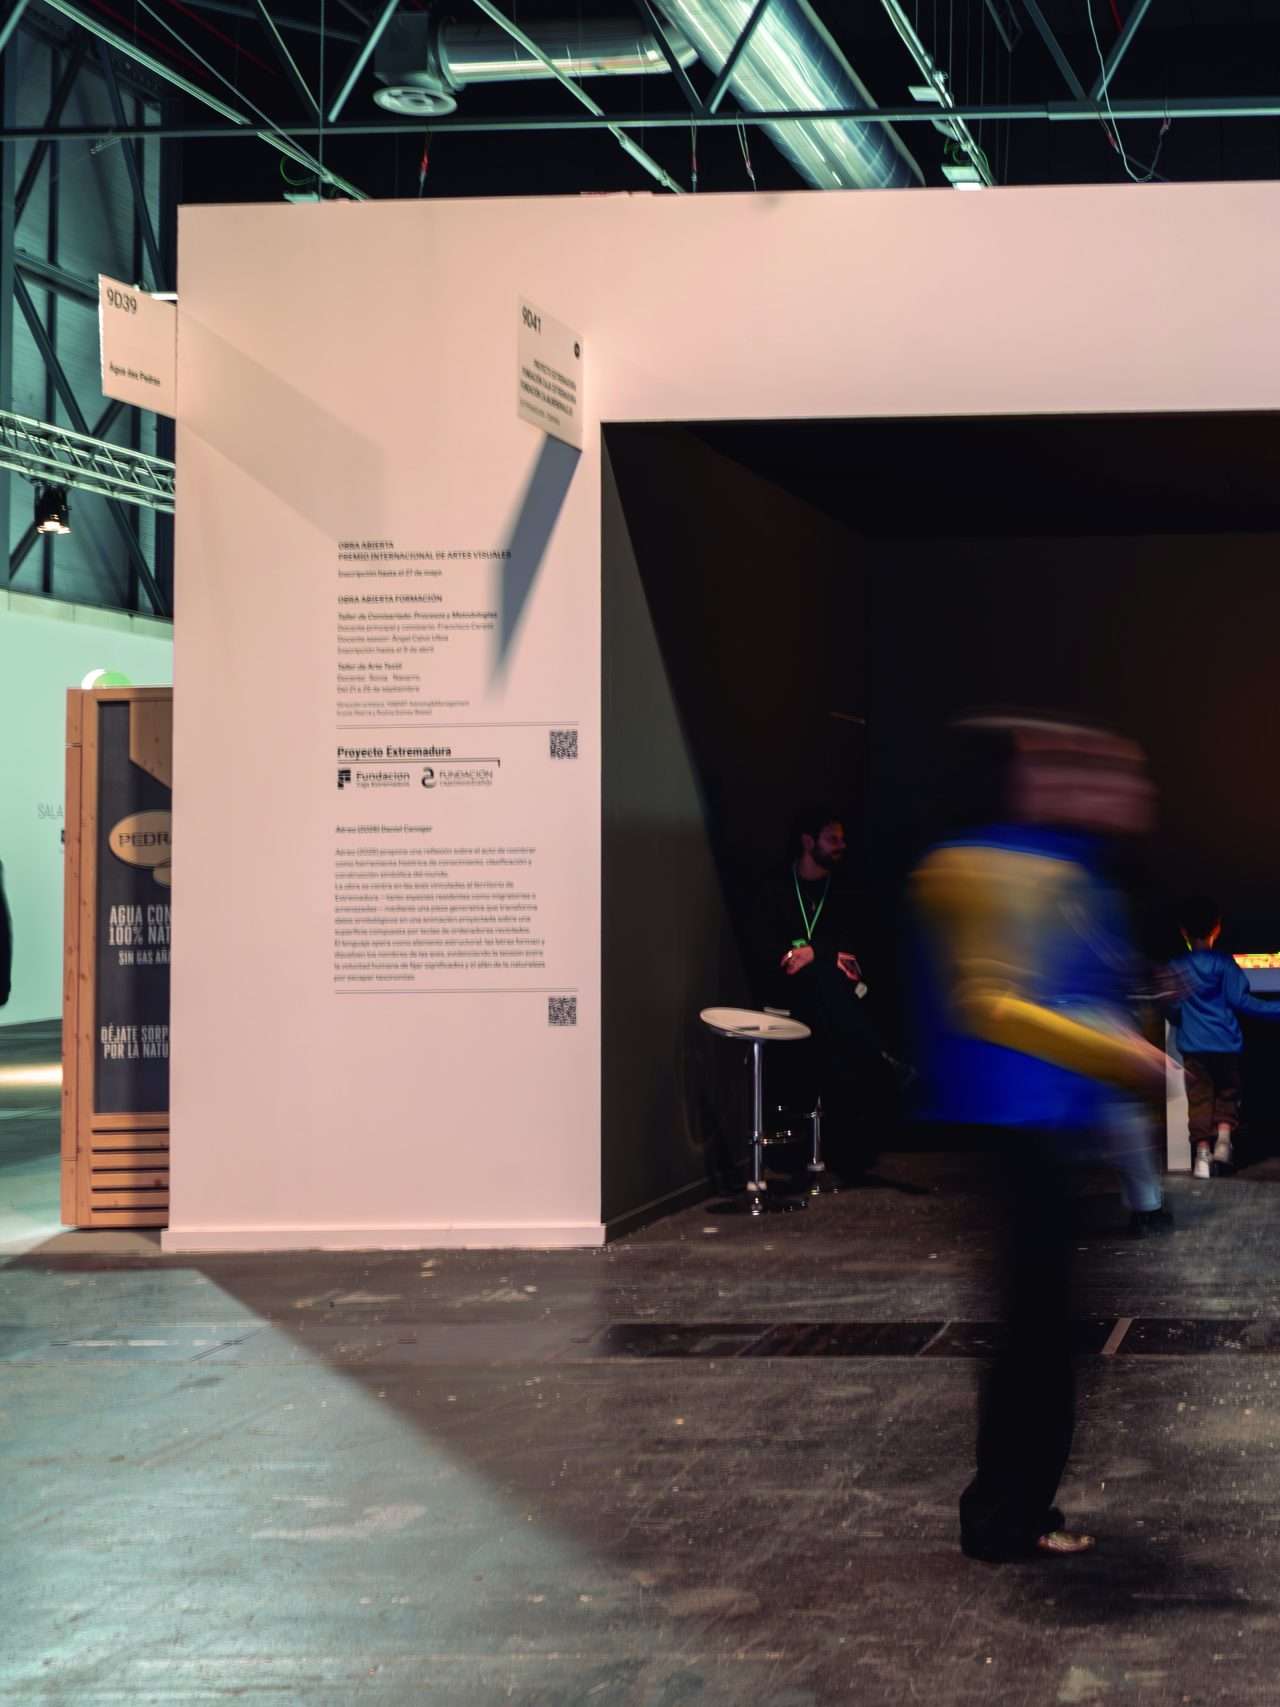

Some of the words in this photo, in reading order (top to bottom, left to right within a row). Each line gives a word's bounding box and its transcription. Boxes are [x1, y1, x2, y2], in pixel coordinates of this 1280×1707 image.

[337, 746, 384, 760] Proyecto
[387, 745, 452, 757] Extremadura
[119, 831, 171, 847] PEDR
[110, 904, 143, 927] AGUA
[109, 926, 143, 946] 100%
[100, 1022, 138, 1044] DÉJATE
[104, 1042, 124, 1060] POR
